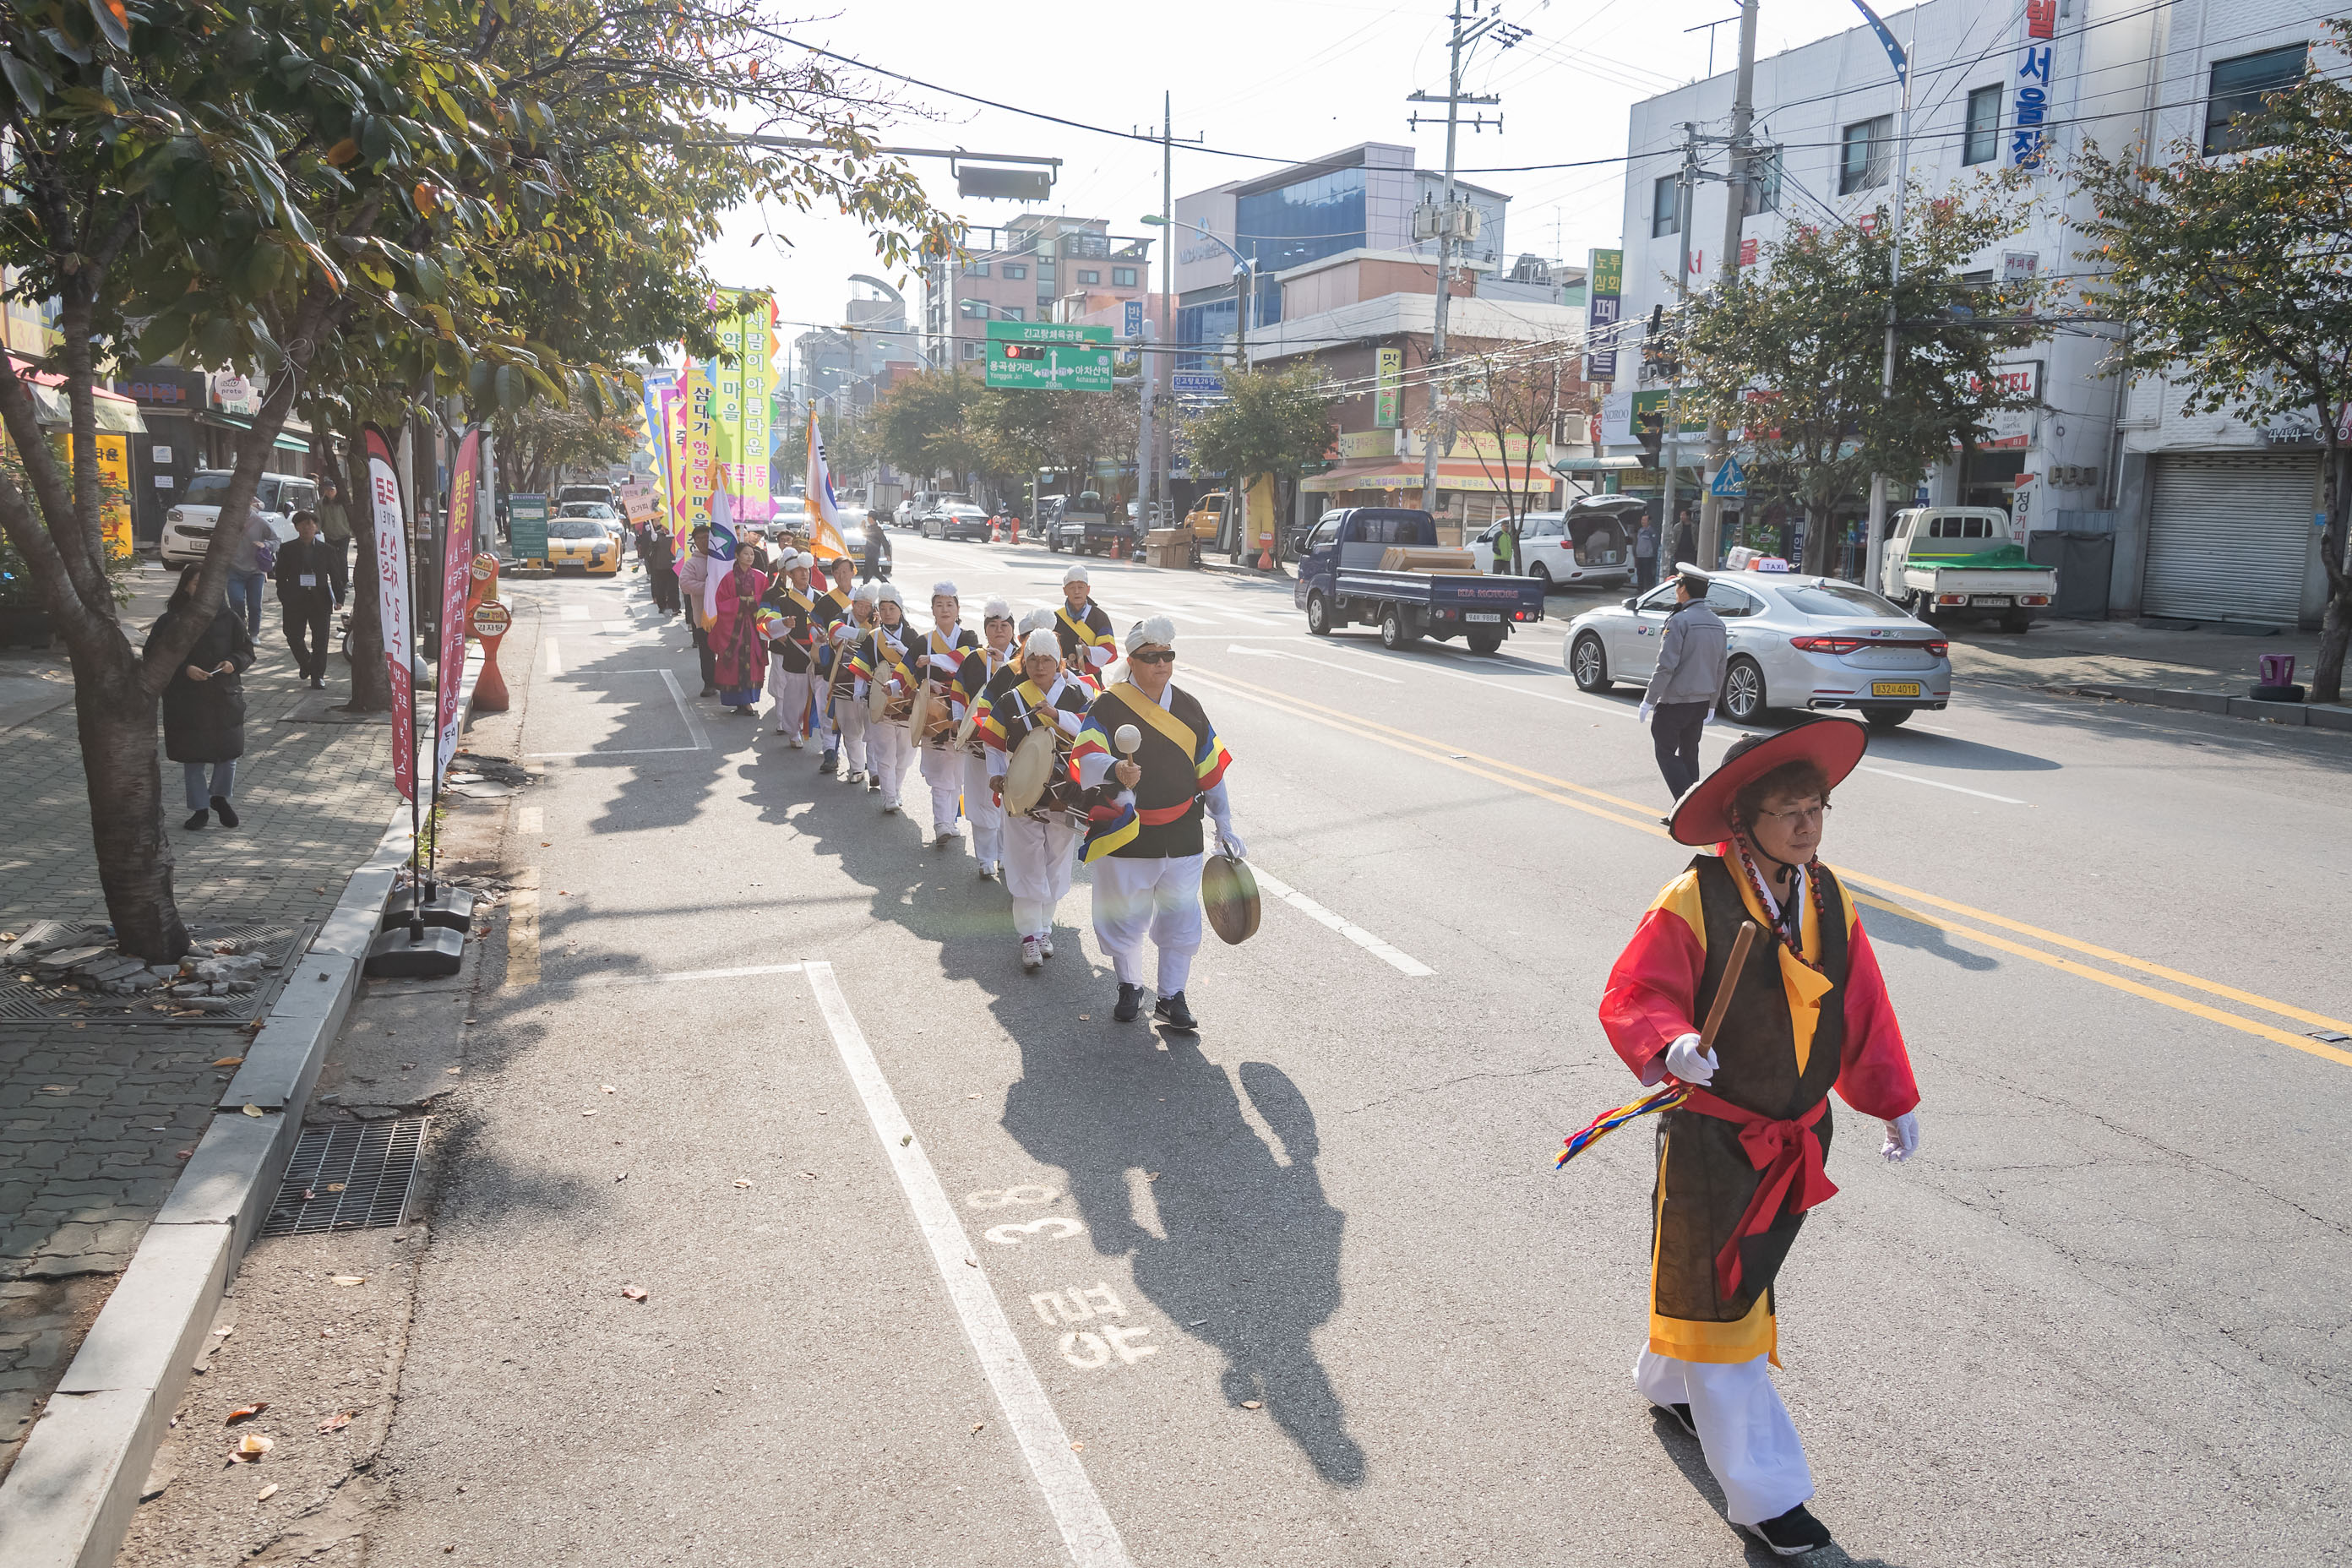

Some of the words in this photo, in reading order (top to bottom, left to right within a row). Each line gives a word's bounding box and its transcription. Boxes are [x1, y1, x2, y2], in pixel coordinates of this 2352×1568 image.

[1595, 253, 1621, 271] 노루
[2006, 257, 2035, 271] 커피숍
[1594, 275, 1620, 292] 삼화
[745, 311, 765, 373] 사람이
[1023, 328, 1083, 340] 긴고랑체육공원
[989, 361, 1033, 373] 용곡삼거리
[1075, 365, 1109, 376] 아차산역
[723, 382, 743, 422] 마을
[693, 387, 712, 437] 삼대가
[745, 377, 765, 456] 아름다운
[692, 441, 710, 490] 행복한
[1457, 588, 1475, 597] KIA
[1478, 590, 1519, 599] MOTORS
[477, 623, 504, 632] 감자탕
